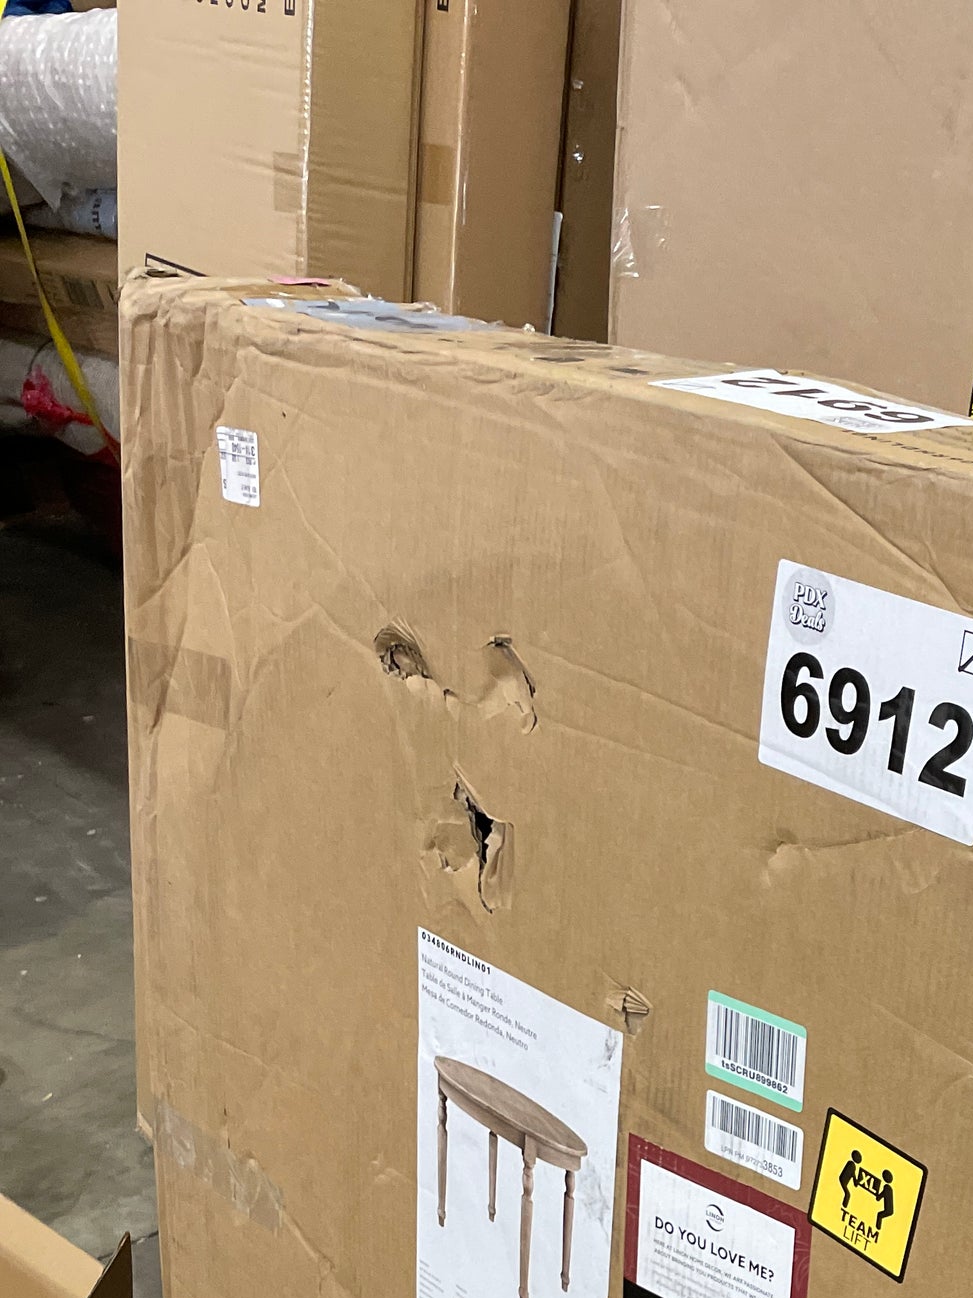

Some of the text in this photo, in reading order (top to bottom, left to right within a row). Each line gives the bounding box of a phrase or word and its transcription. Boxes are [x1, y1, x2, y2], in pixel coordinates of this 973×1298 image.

[720, 377, 935, 425] 6912
[793, 582, 828, 610] PDX
[789, 605, 826, 632] Deals
[421, 931, 492, 975] 034806RNDLIN01
[421, 953, 504, 1005] Natural Round Dining Table
[421, 968, 438, 985] Table
[438, 979, 446, 990] de
[446, 980, 461, 998] Salle
[466, 992, 491, 1017] Manger
[491, 1006, 513, 1027] Ronde,
[514, 1018, 538, 1040] Neutre
[421, 984, 438, 1001] Mesa
[438, 993, 446, 1005] de
[446, 997, 474, 1021] Comedor
[506, 1031, 529, 1050] Neutro
[721, 1059, 788, 1094] tsSCRU899862
[860, 1171, 877, 1194] XL
[705, 1208, 725, 1224] LINON
[840, 1208, 879, 1244] TEAM
[655, 1216, 774, 1283] DO YOU LOVE ME?
[843, 1225, 871, 1252] LIFT
[653, 1238, 666, 1249] HERE
[689, 1253, 704, 1266] HOME
[724, 1270, 732, 1279] WE
[732, 1275, 744, 1285] ARE
[654, 1247, 671, 1261] ABOUT
[671, 1255, 695, 1272] BRINGING
[695, 1266, 707, 1278] YOU
[707, 1272, 734, 1291] PRODUCTS
[735, 1284, 749, 1297] THAT
